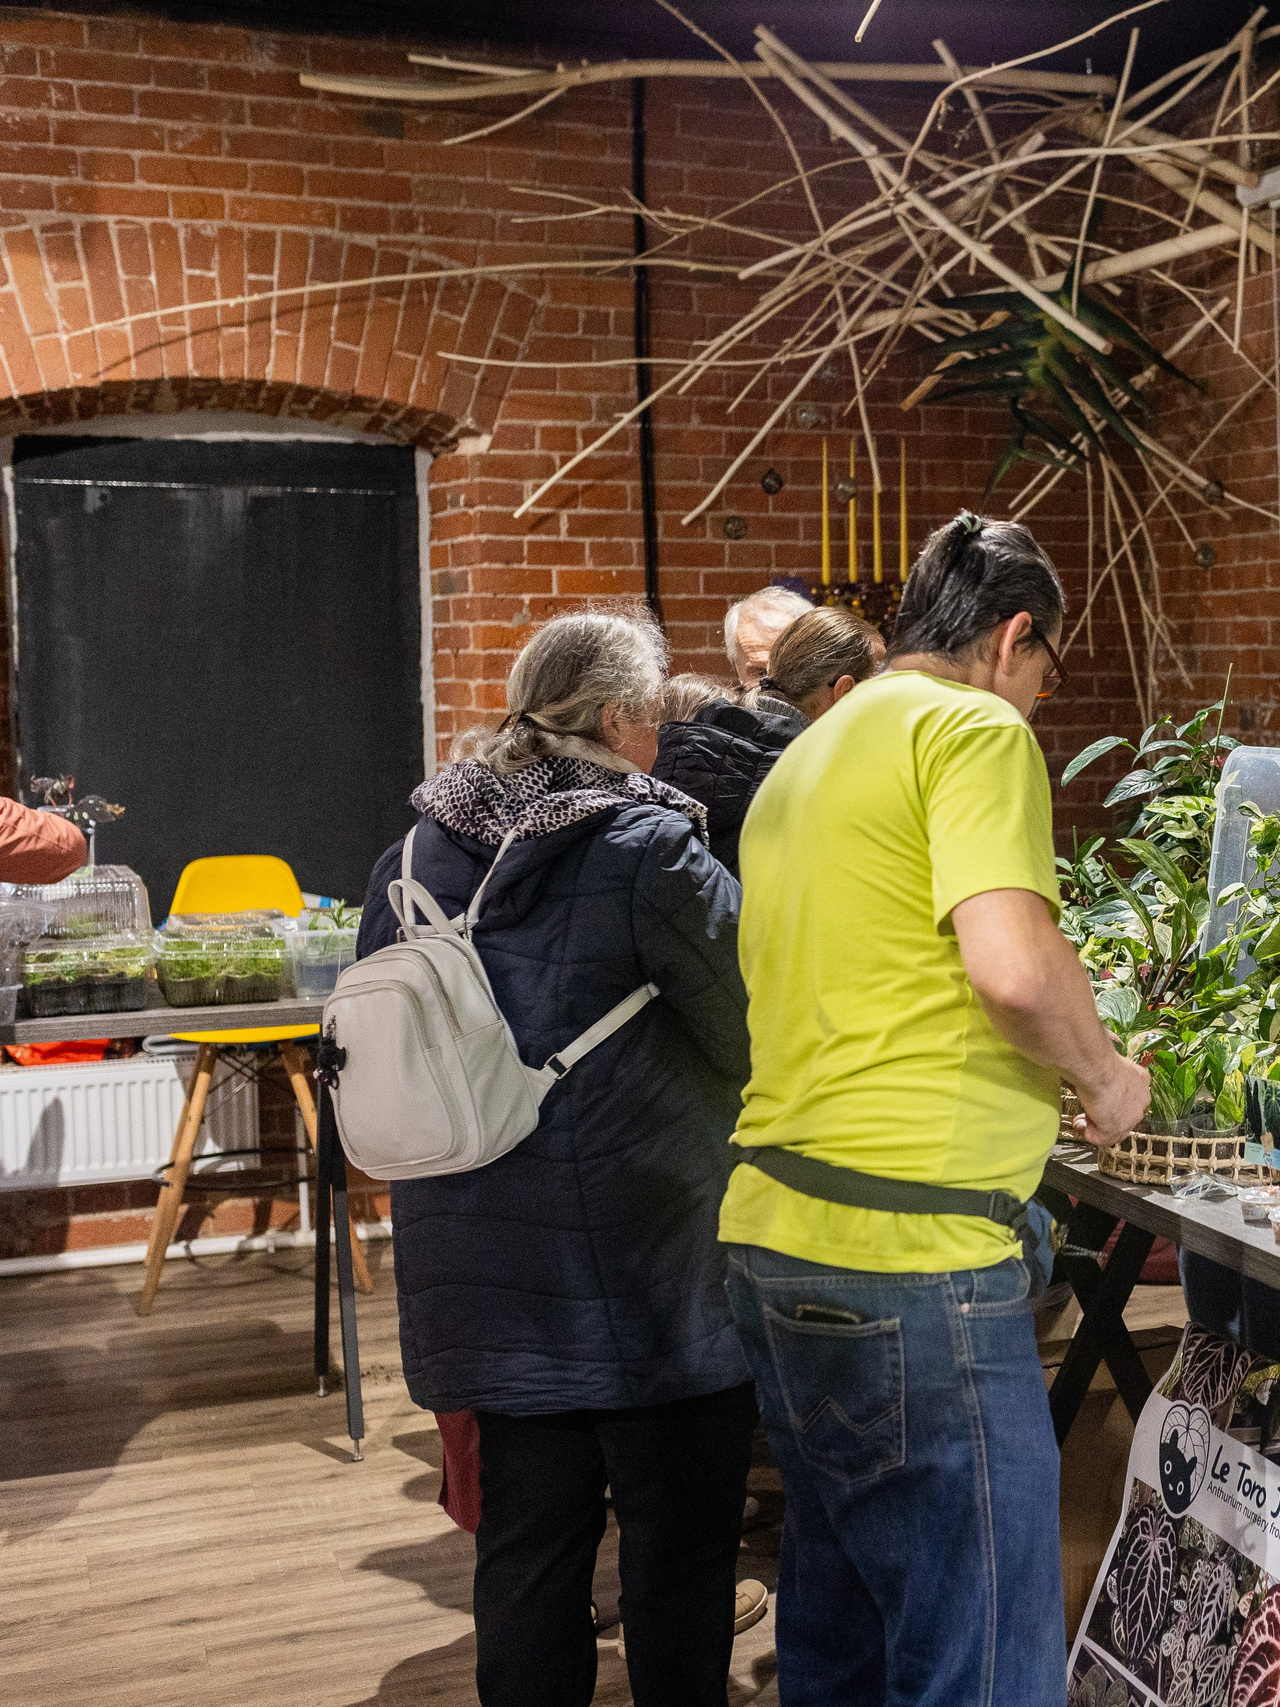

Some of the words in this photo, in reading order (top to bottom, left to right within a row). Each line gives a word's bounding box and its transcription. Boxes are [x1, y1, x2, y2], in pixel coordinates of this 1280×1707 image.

[1211, 1444, 1231, 1483] Le
[1237, 1461, 1267, 1509] Toro
[1207, 1480, 1242, 1513] Anthurium
[1242, 1506, 1269, 1533] nursery
